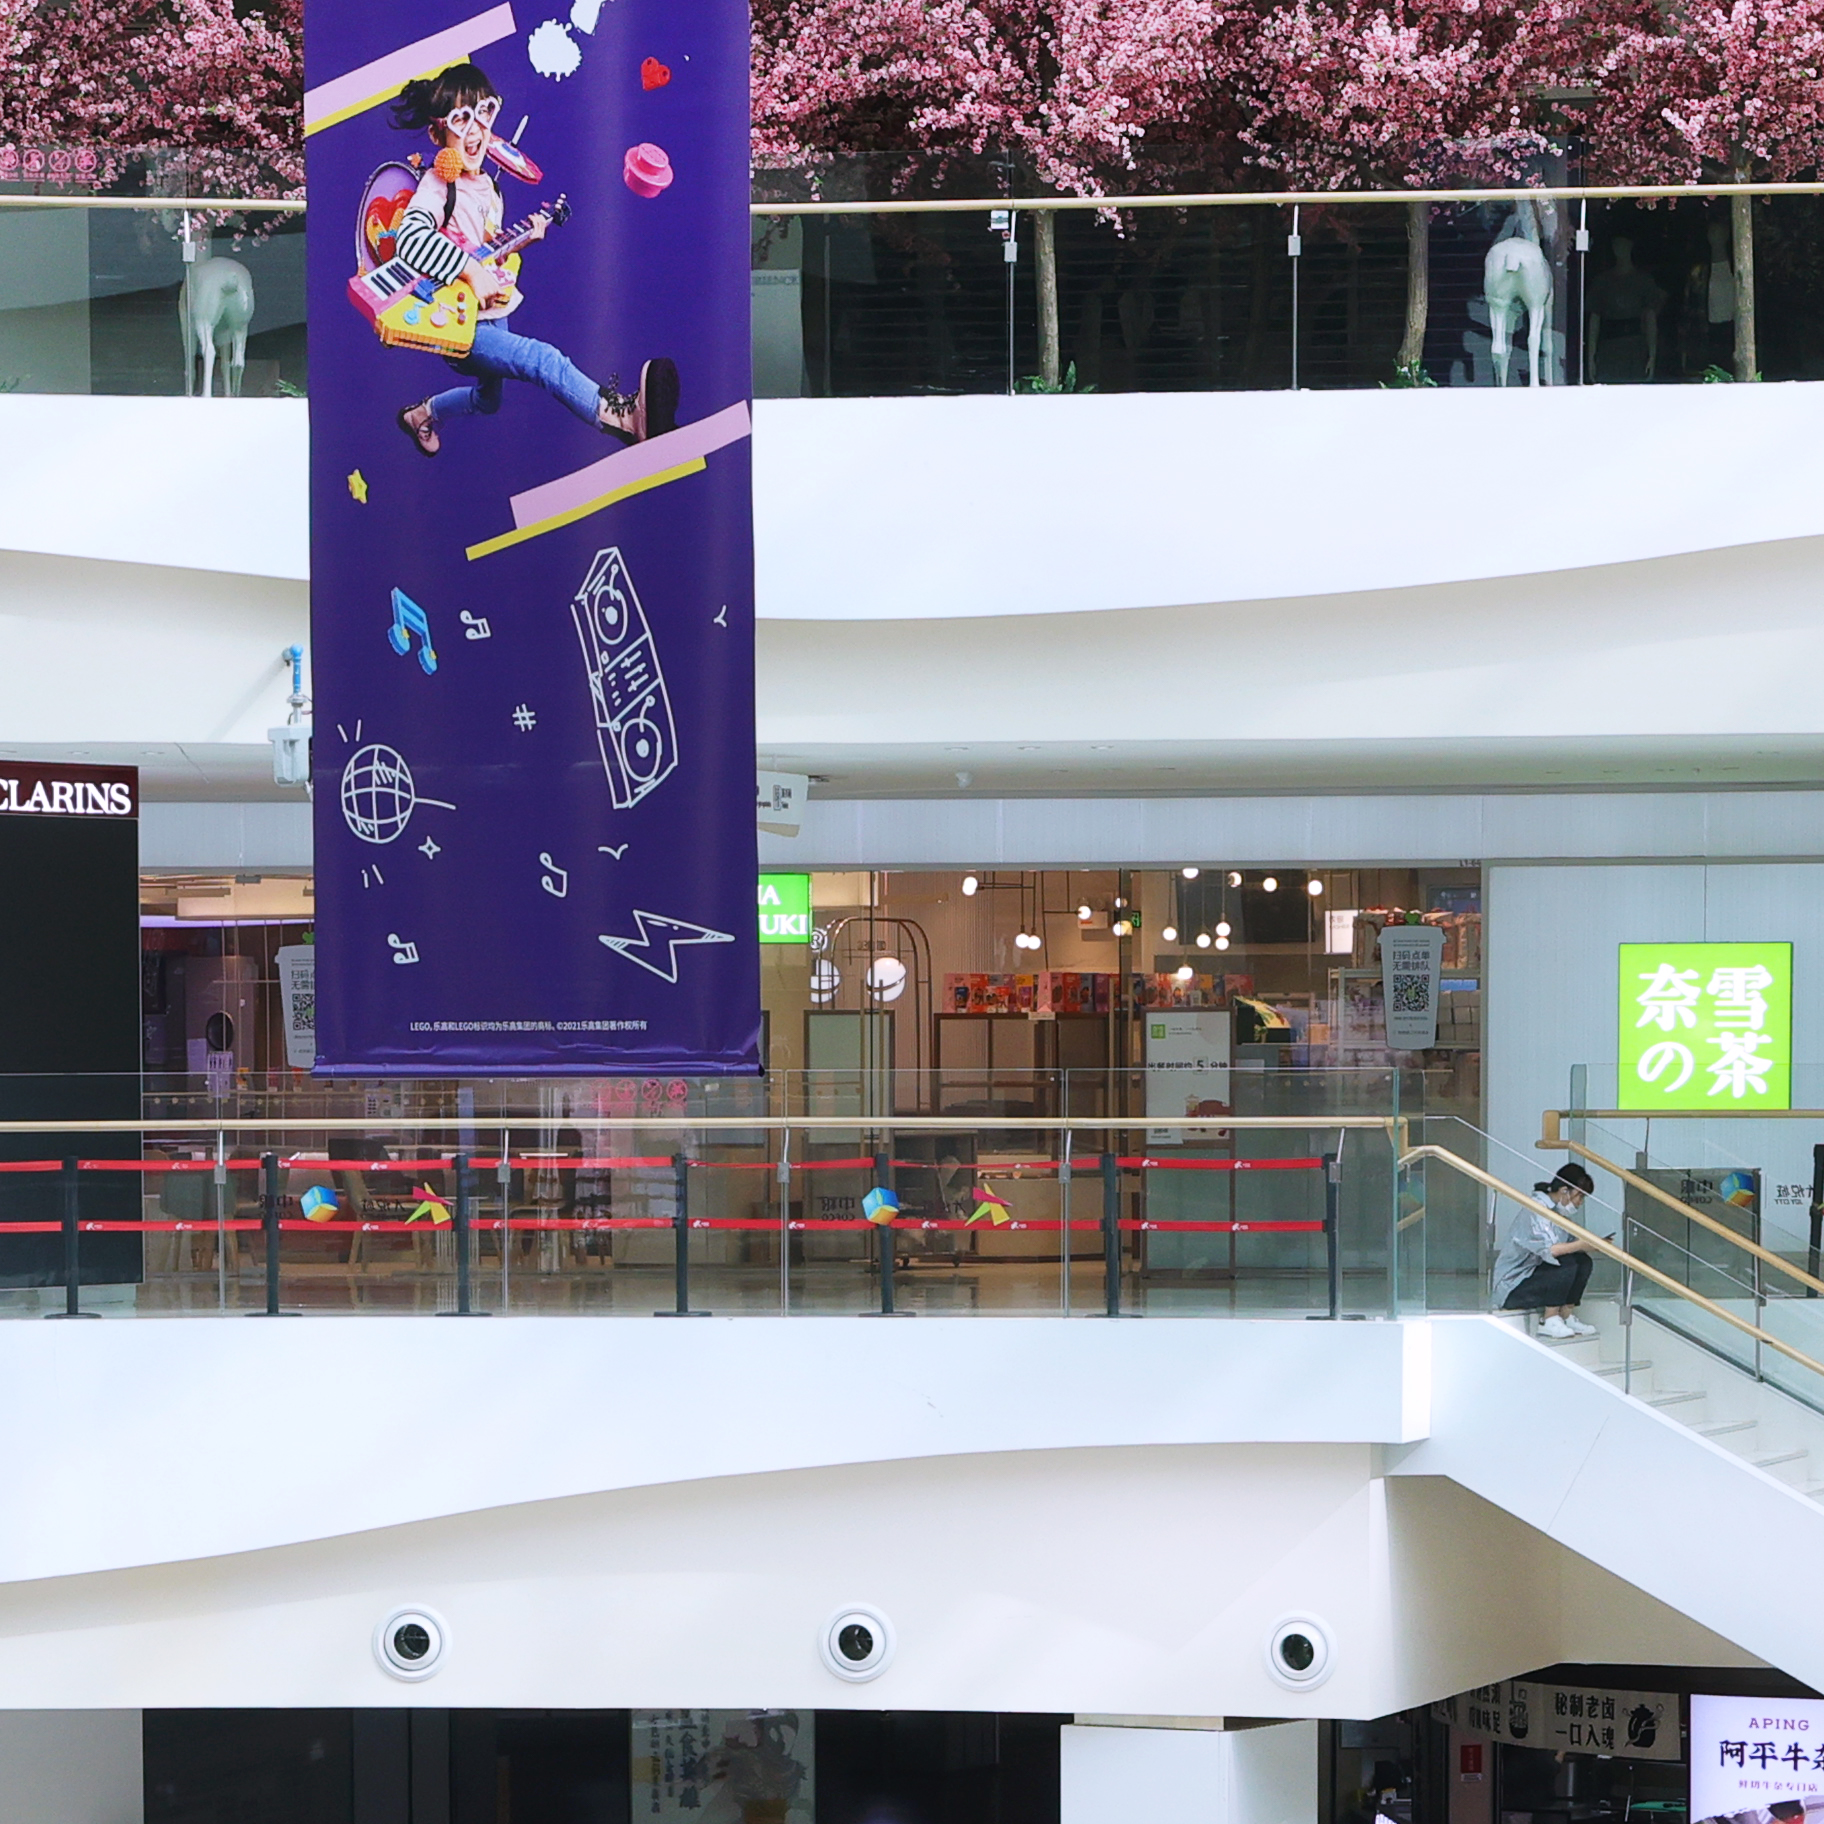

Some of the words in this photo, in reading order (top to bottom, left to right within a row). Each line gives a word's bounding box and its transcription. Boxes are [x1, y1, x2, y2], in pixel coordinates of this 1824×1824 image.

[1555, 1692, 1616, 1722] 秘制老卤
[1555, 1724, 1616, 1751] 一口入魂
[1748, 1716, 1812, 1732] APING
